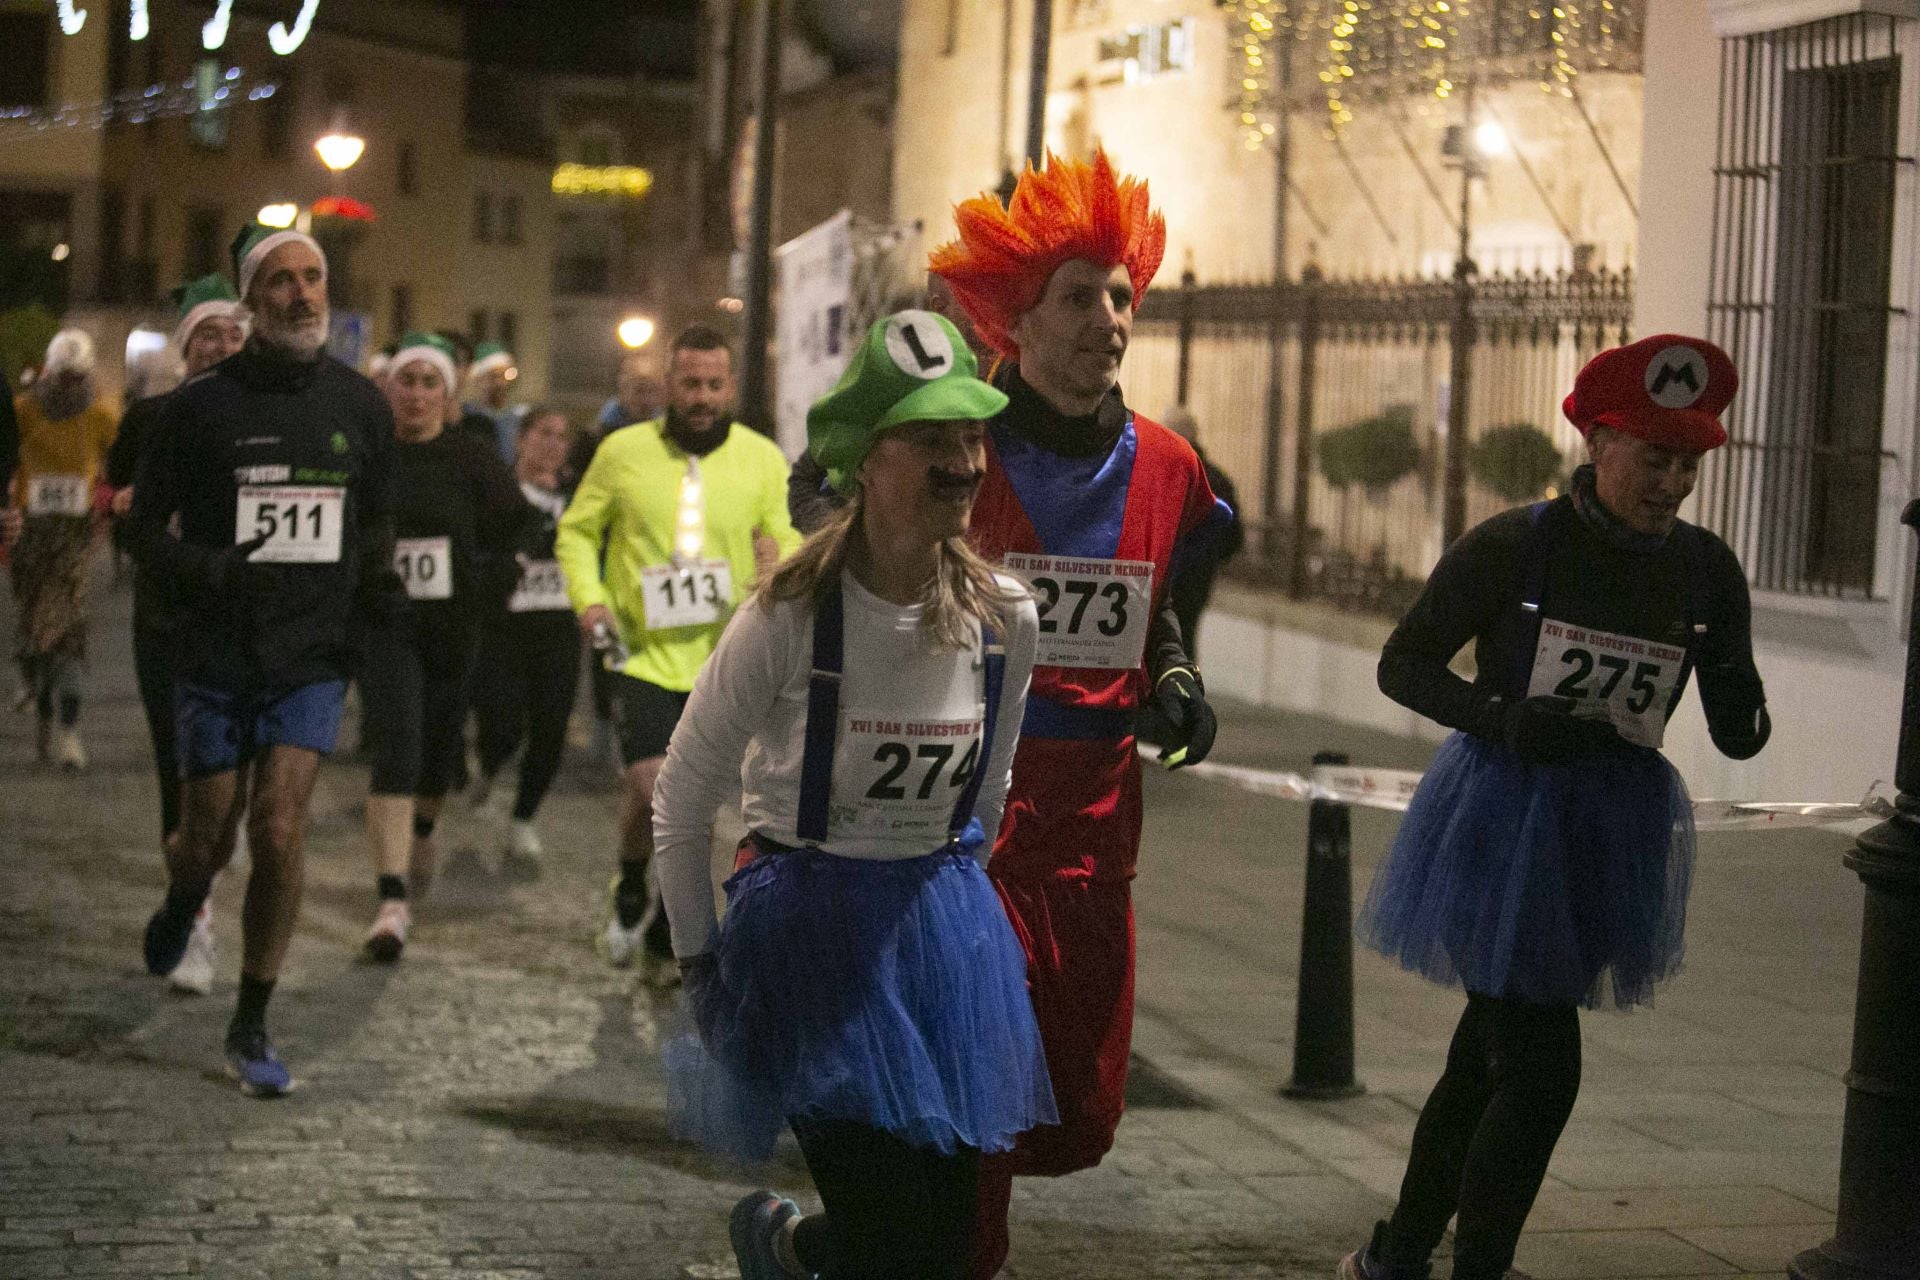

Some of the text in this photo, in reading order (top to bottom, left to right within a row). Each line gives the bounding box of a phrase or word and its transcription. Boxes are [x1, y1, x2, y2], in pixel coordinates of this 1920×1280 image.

[901, 324, 945, 371] L
[1650, 362, 1699, 394] M
[256, 503, 323, 540] 511
[1008, 558, 1150, 577] XVI SAN SILVESTRE MERIDA
[660, 574, 720, 608] 113
[1031, 577, 1128, 637] 273
[1544, 623, 1563, 637] XVI
[1565, 628, 1586, 643] SAN
[1589, 633, 1644, 655] SILVESTRE
[1553, 647, 1661, 714] 275
[850, 720, 872, 734] XVI
[876, 720, 901, 735] SAN
[905, 723, 971, 737] SILVESTRE
[865, 737, 979, 801] 274
